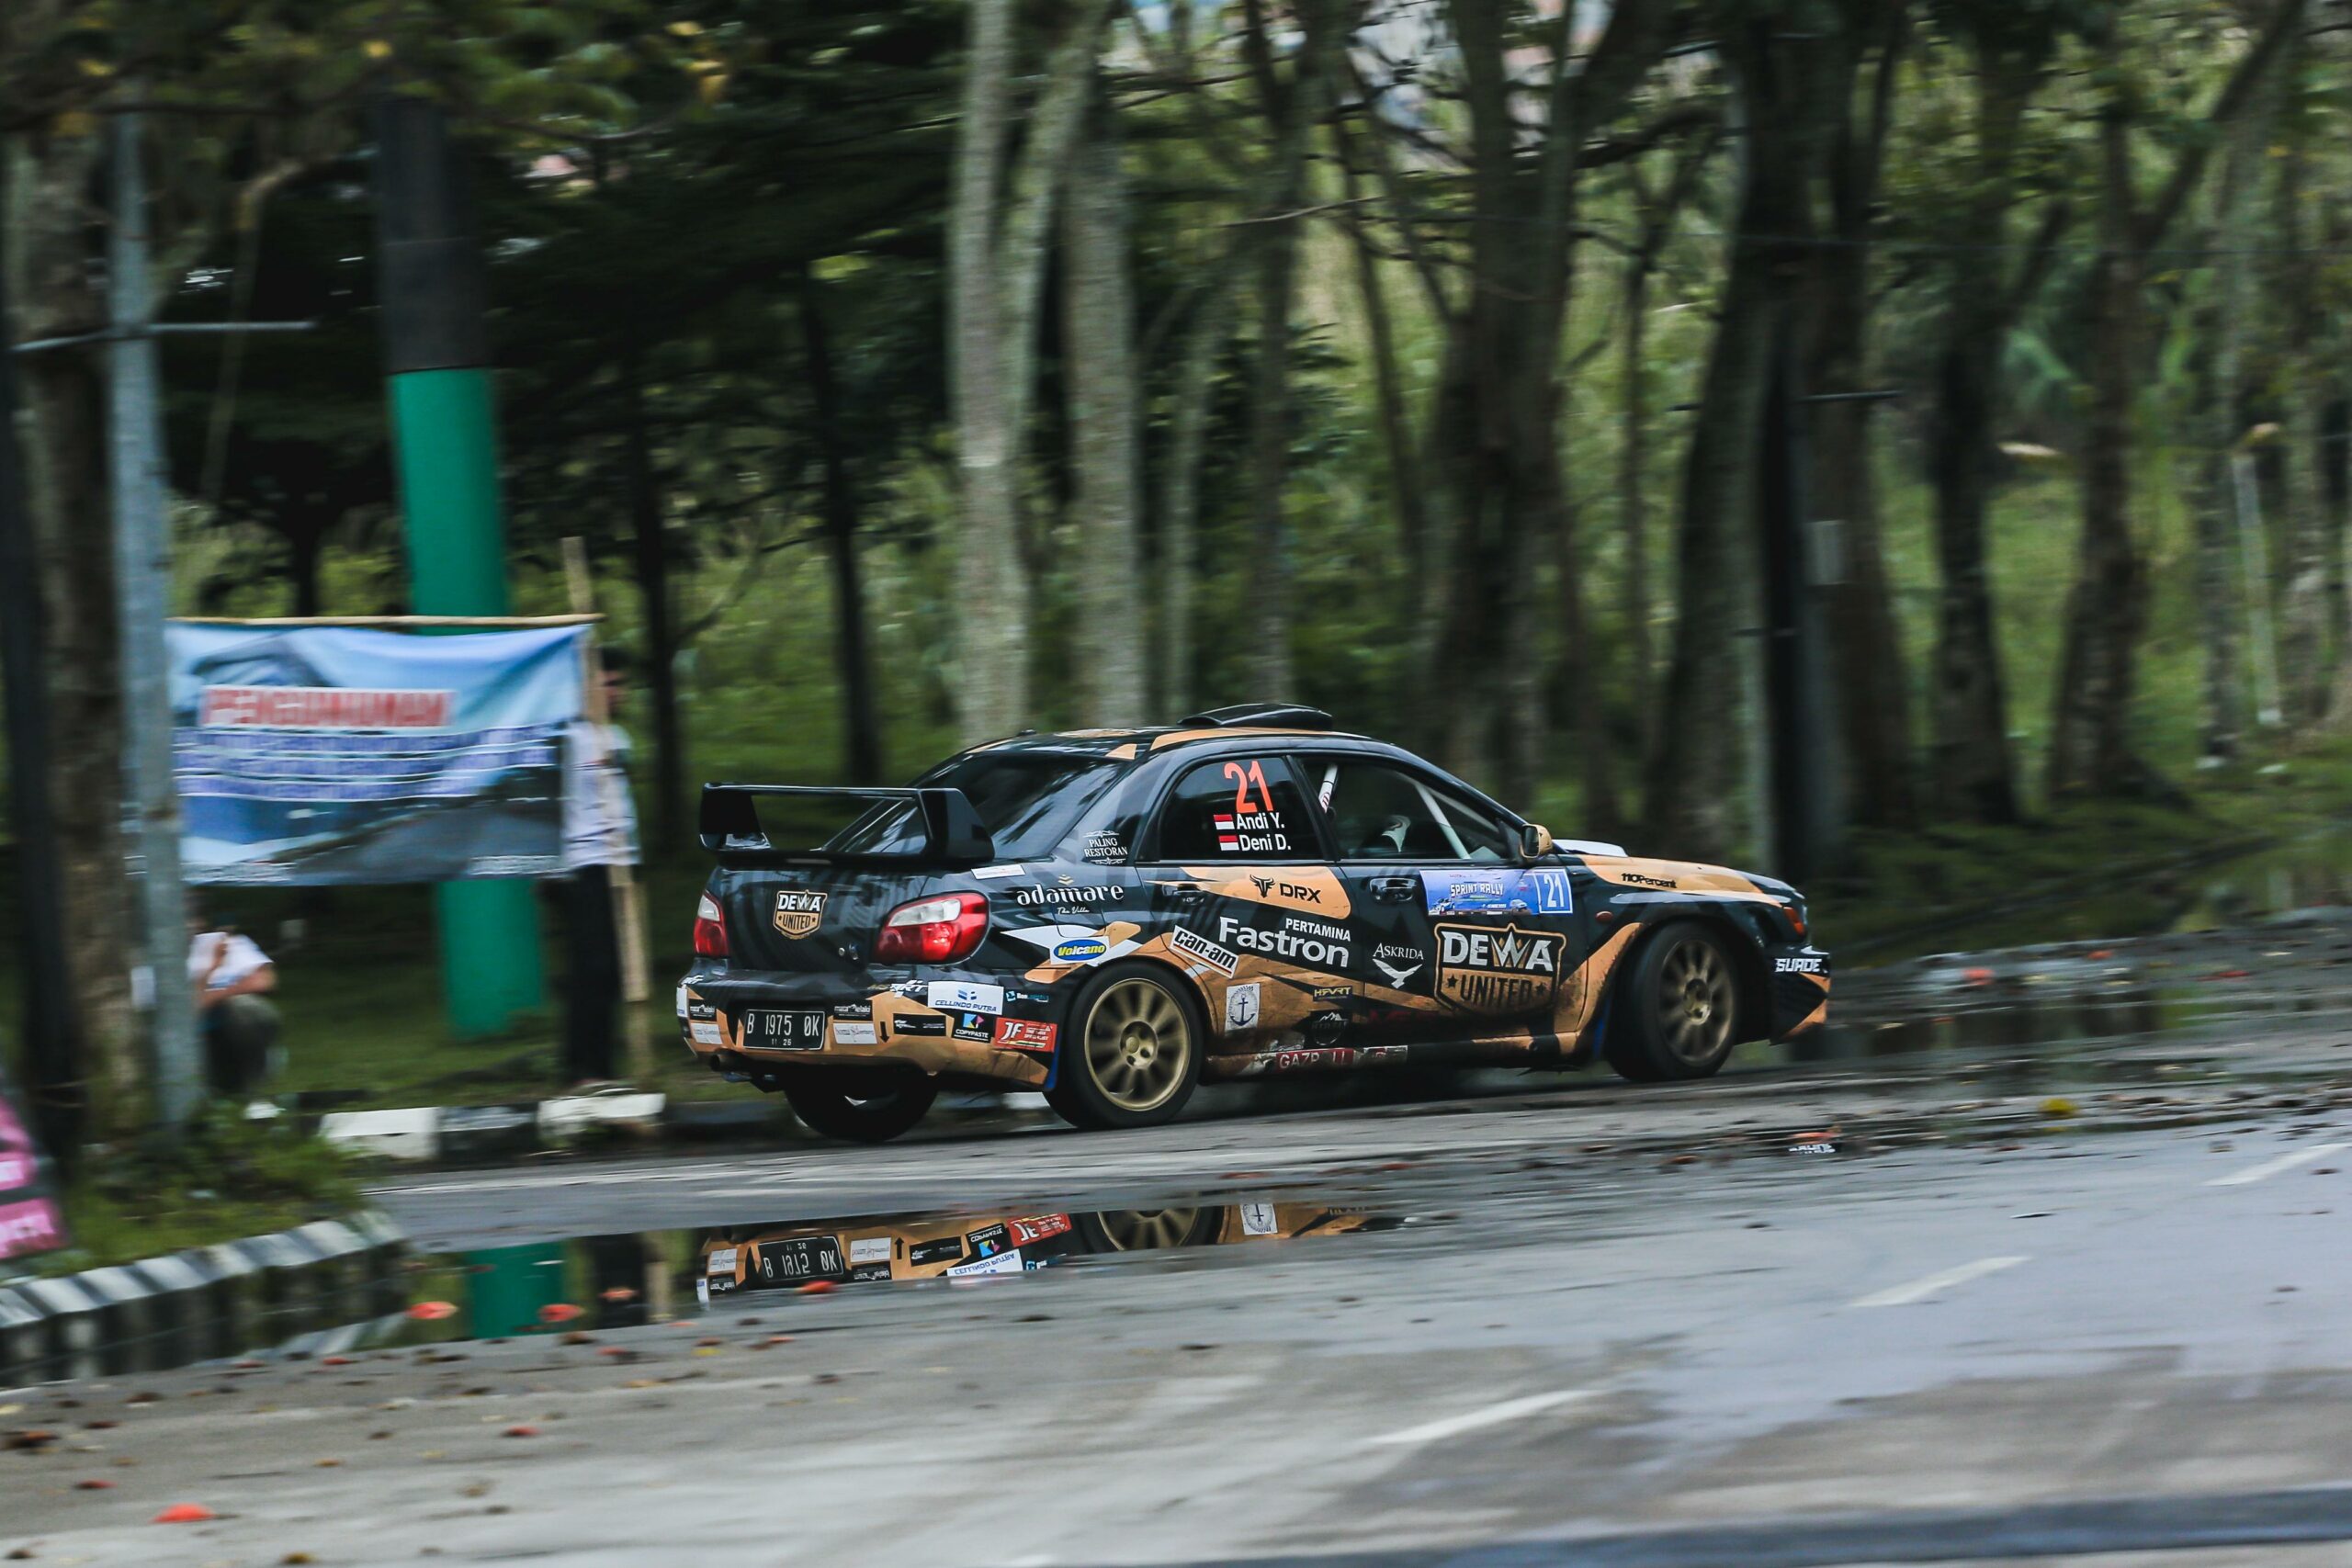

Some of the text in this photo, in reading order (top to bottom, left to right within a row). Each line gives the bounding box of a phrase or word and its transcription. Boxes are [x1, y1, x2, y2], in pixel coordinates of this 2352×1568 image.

[1224, 760, 1273, 813] 21
[1237, 812, 1285, 829] Andi Y.
[1084, 846, 1128, 857] RESTORAN
[1088, 838, 1118, 847] PALING
[1238, 833, 1291, 852] Deni D.
[1016, 884, 1124, 906] adamare
[1280, 883, 1322, 904] DRX
[1450, 884, 1477, 897] SPRINT
[1479, 883, 1504, 896] RALLY
[1544, 873, 1565, 908] 21
[778, 893, 821, 911] DEWA
[783, 914, 810, 930] UNITED
[1285, 918, 1351, 942] PERTAMINA
[1057, 945, 1106, 956] Volcano
[1174, 931, 1237, 968] can-am
[1218, 916, 1350, 968] Fastron
[1373, 942, 1424, 960] ASKRIDA
[1441, 931, 1554, 972] DEWA
[1460, 975, 1532, 1009] UNITED
[935, 999, 997, 1012] CELLINDO PUTRA
[746, 1013, 755, 1034] B
[765, 1014, 792, 1036] 1975
[956, 1029, 989, 1038] COPYPASTE
